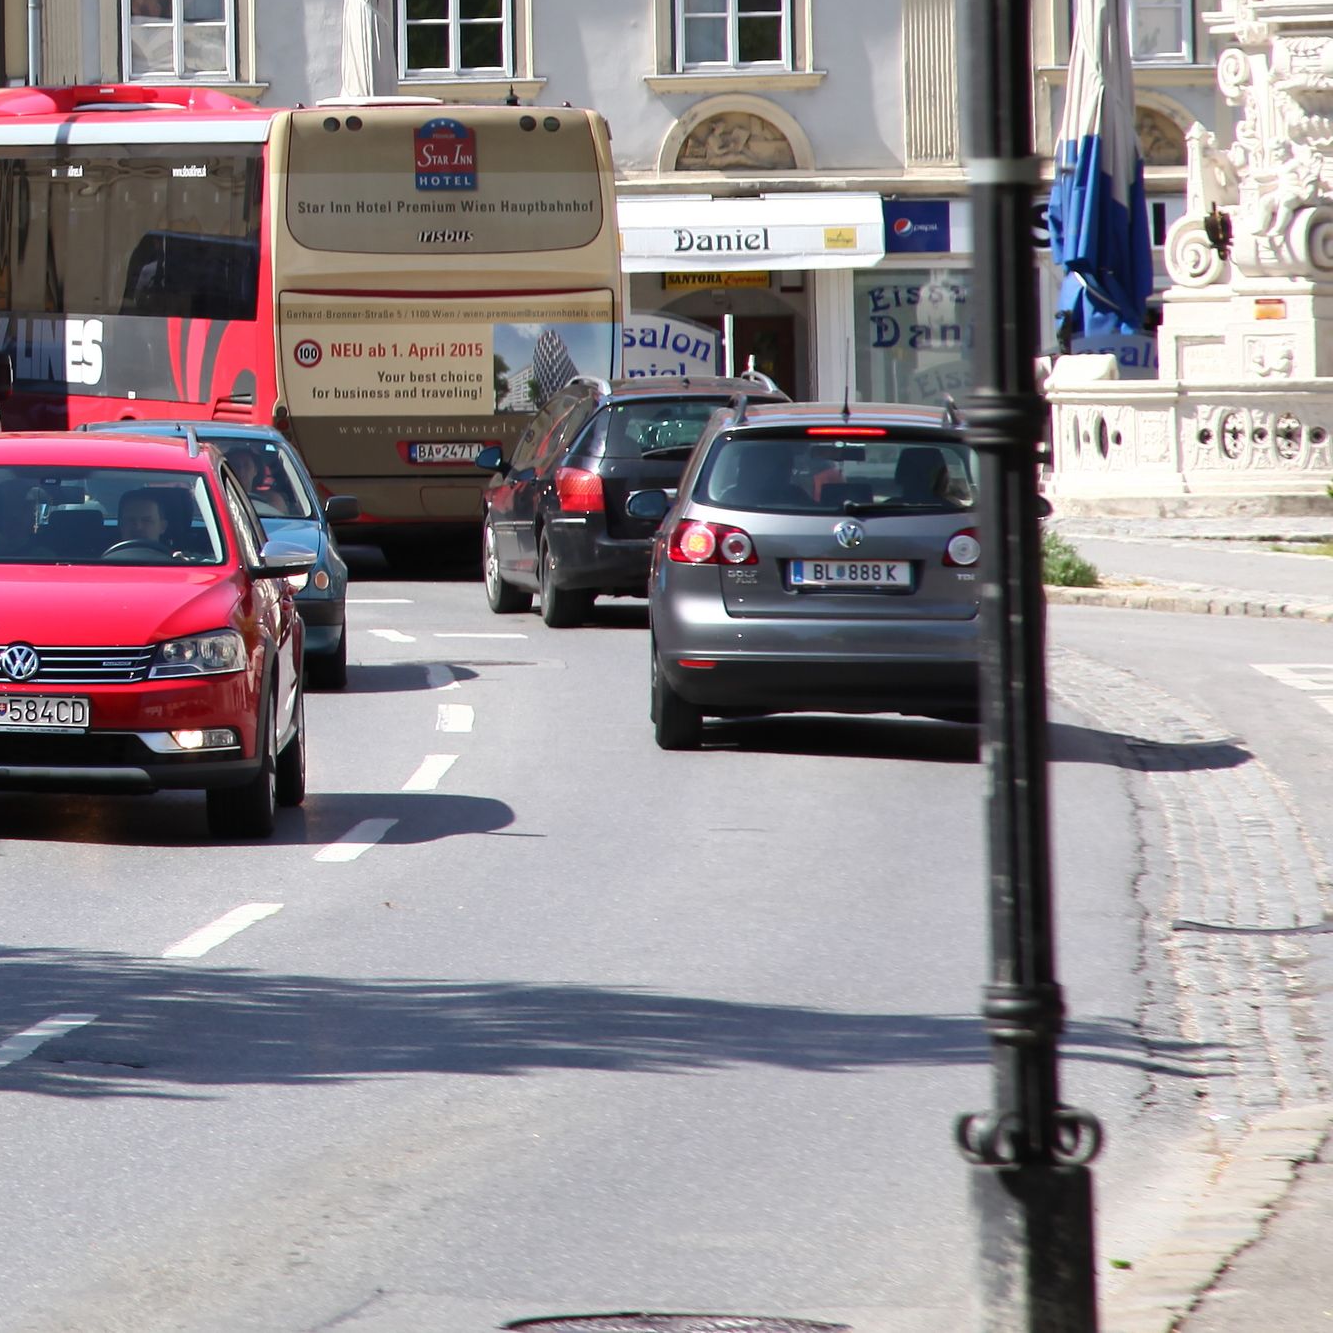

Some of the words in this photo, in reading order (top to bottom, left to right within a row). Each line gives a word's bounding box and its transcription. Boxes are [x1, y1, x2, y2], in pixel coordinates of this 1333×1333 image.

[419, 175, 471, 186] HOTEL
[297, 200, 325, 215] Star
[330, 200, 351, 214] Inn
[356, 200, 391, 214] Hotel
[397, 200, 456, 214] Premium
[461, 200, 496, 214] Wien
[501, 200, 594, 215] Hauptbahnhof
[913, 223, 939, 233] pepsi
[417, 229, 475, 243] irisbus
[673, 227, 770, 252] Daniel
[667, 273, 722, 285] SANTORA
[868, 284, 967, 313] Eissa
[433, 309, 454, 318] Wien
[623, 323, 711, 362] salon
[299, 348, 317, 360] 100
[330, 343, 362, 358] NEU
[368, 343, 386, 357] ab
[391, 343, 404, 357] 1.
[408, 342, 445, 360] April
[450, 342, 483, 357] 2015
[377, 370, 406, 383] Your
[409, 370, 437, 383] best
[440, 370, 483, 383] choice
[312, 386, 329, 399] for
[334, 386, 390, 399] business
[394, 386, 417, 399] and
[421, 386, 483, 401] traveling!
[339, 423, 523, 435] www.starinnhotels.
[813, 561, 834, 581] BL
[848, 561, 882, 581] 888
[886, 562, 896, 581] K
[8, 699, 85, 724] 584CD
